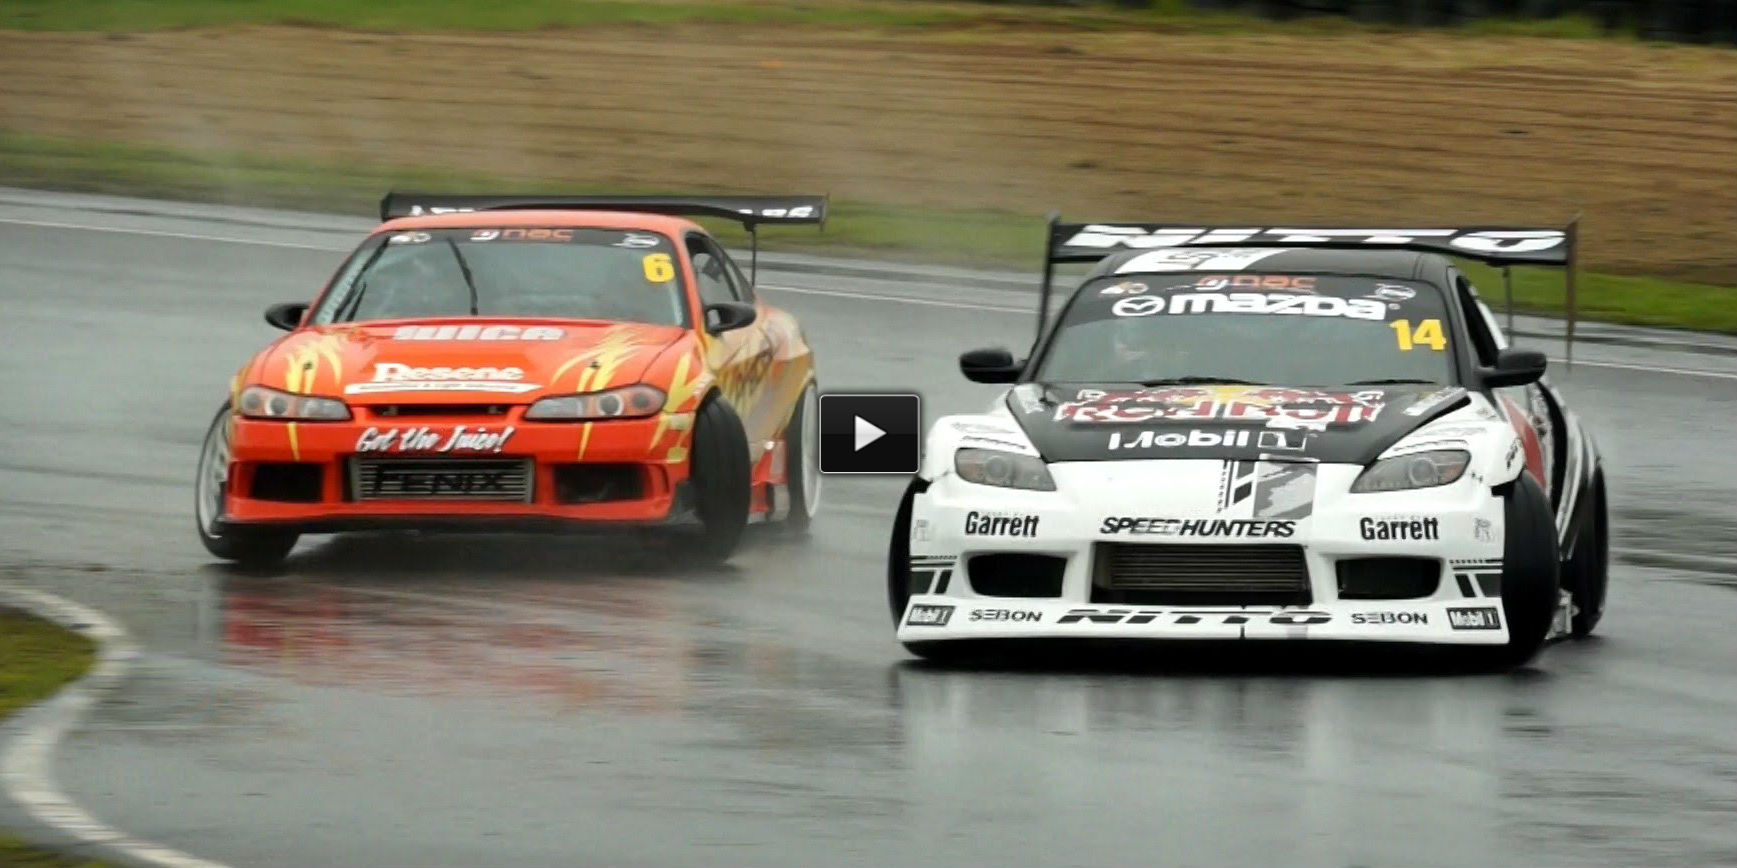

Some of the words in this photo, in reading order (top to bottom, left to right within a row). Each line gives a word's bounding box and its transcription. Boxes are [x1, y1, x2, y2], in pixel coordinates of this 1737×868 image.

[1063, 224, 1567, 253] NITTO
[642, 252, 675, 283] 6
[1388, 318, 1447, 351] 14
[372, 362, 525, 383] Resene
[355, 427, 399, 452] Got
[399, 427, 441, 451] the
[1107, 430, 1250, 451] Mobil
[965, 510, 1040, 538] Garrett
[1099, 516, 1297, 539] SPEEDHUNTERS
[1360, 516, 1440, 541] Garrett
[1056, 608, 1333, 625] NITTO
